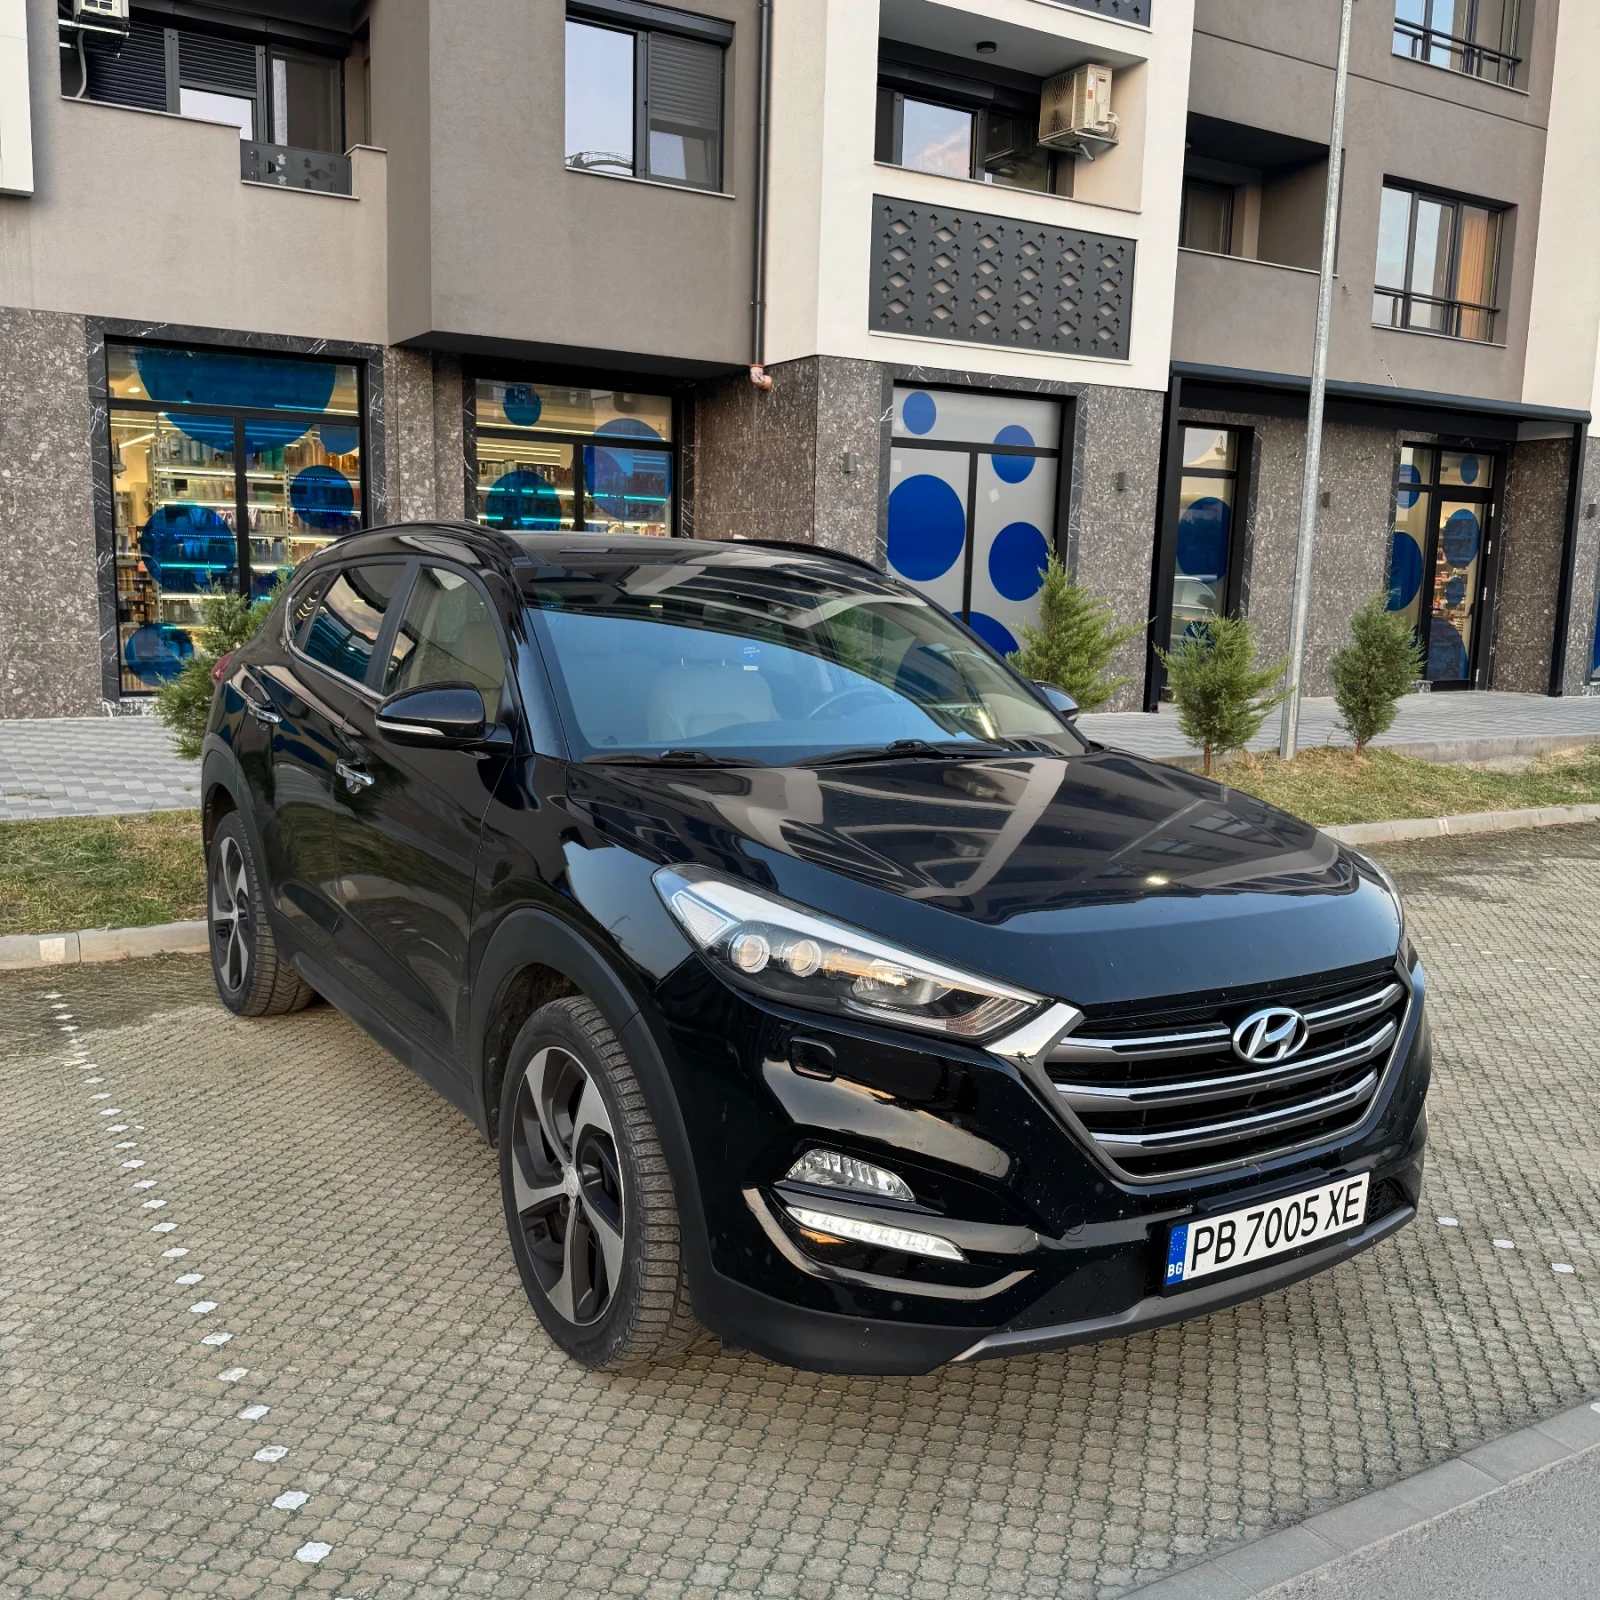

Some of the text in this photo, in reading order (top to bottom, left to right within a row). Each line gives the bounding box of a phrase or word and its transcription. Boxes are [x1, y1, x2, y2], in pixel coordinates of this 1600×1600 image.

[1191, 1181, 1363, 1271] PB 7005 XE
[1167, 1261, 1183, 1277] BG
